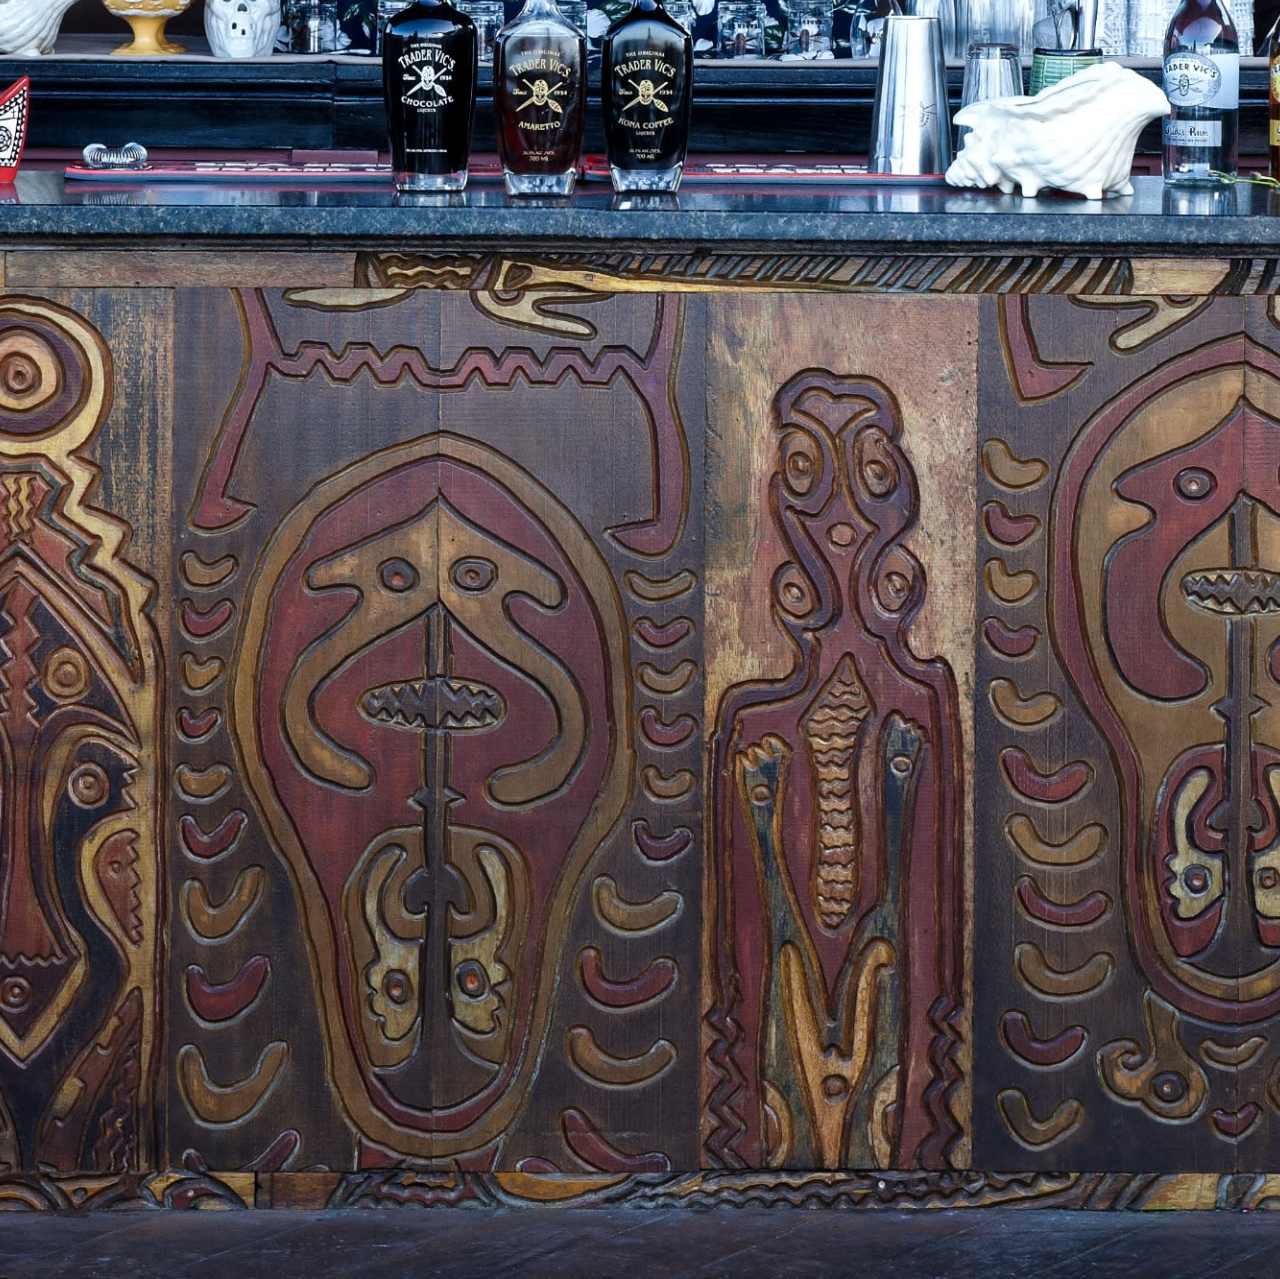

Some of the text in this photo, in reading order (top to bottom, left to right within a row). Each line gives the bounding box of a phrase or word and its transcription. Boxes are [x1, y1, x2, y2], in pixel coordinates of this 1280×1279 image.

[398, 49, 456, 71] TRADER VIC'S
[509, 58, 571, 78] TRADER VIC'S
[614, 58, 676, 78] TRADER VIC'S
[401, 96, 454, 108] CHOCOLATE
[518, 120, 561, 131] AMARETTO
[618, 116, 674, 130] KONA COFFEE
